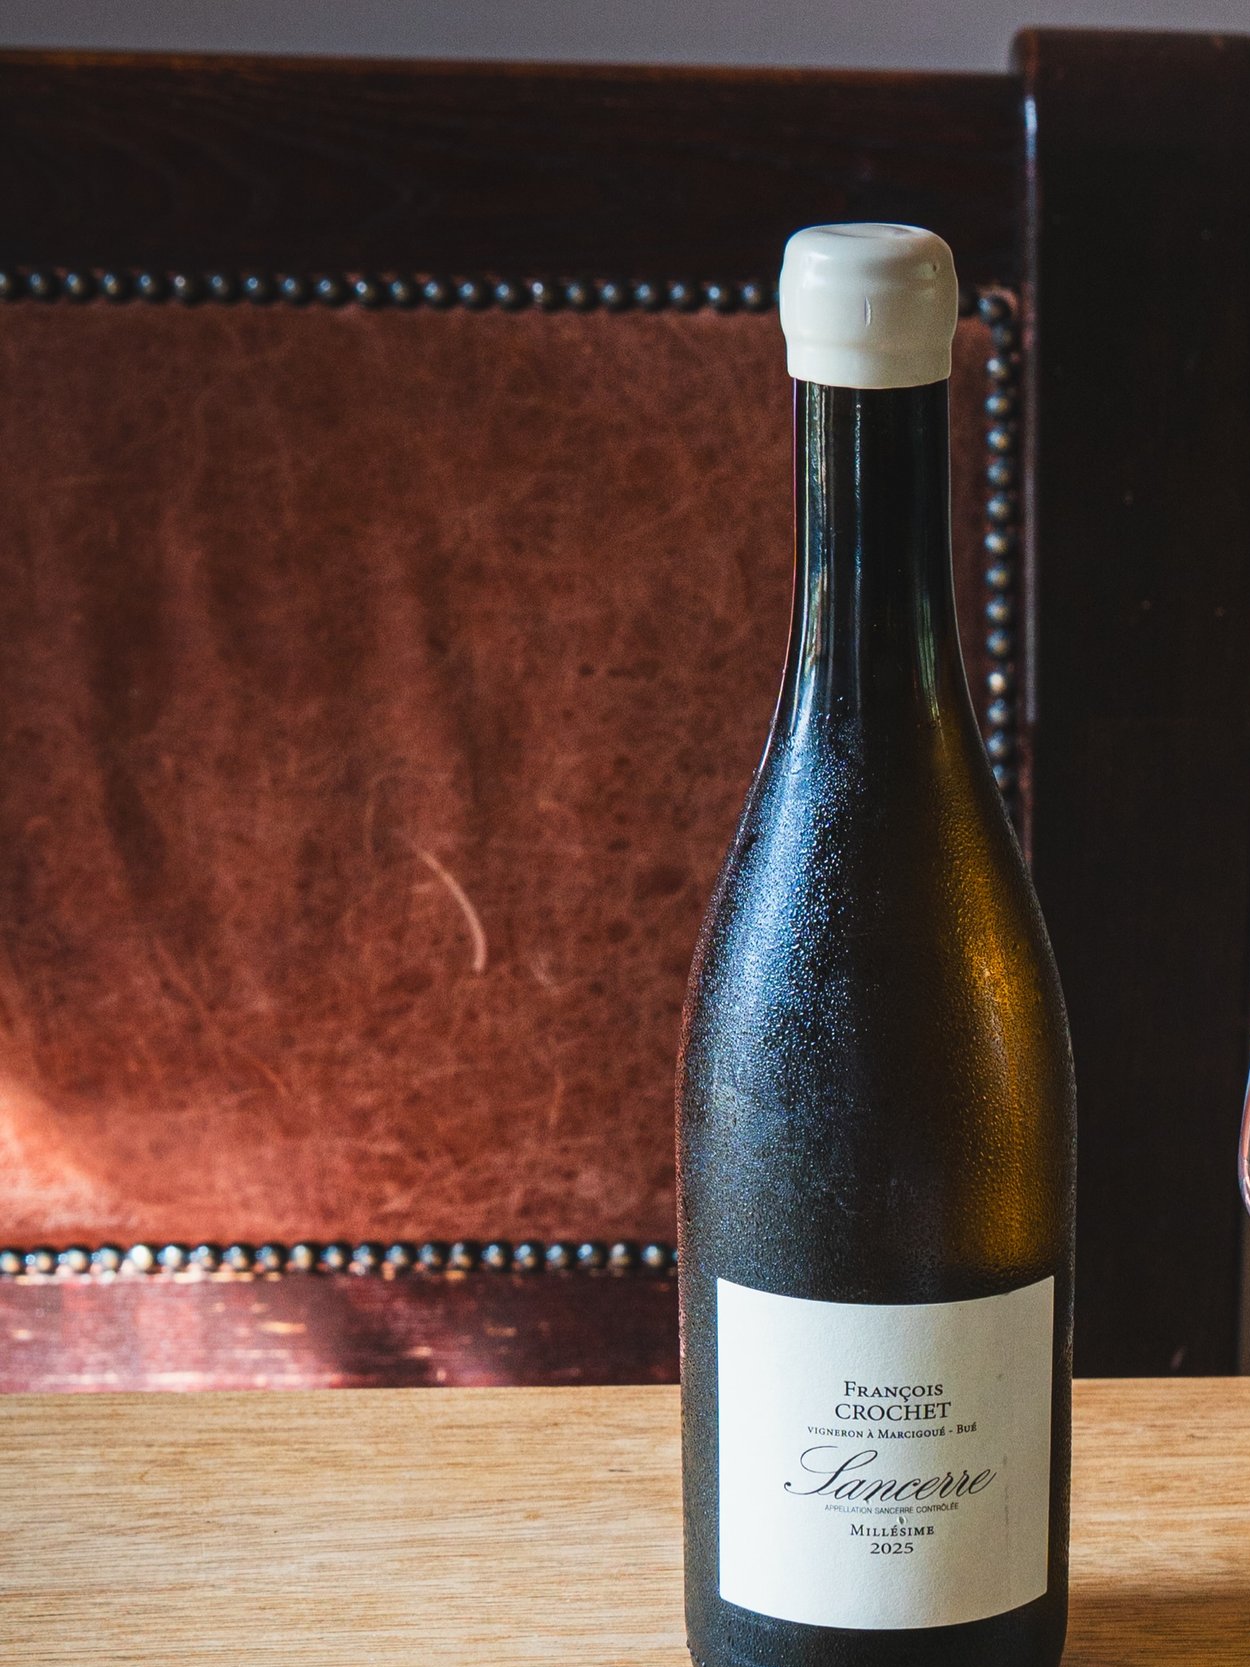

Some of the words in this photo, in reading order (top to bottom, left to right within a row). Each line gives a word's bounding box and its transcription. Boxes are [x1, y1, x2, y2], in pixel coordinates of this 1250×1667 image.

[835, 1402, 952, 1421] CROCHET
[807, 1426, 863, 1438] VIGNERON
[867, 1427, 874, 1439] À
[784, 1445, 997, 1503] Sancerre
[824, 1504, 872, 1514] APPELLATION
[875, 1506, 913, 1515] SANCERRE
[916, 1502, 959, 1514] CONTRÔLÉE
[870, 1542, 914, 1554] 2025
